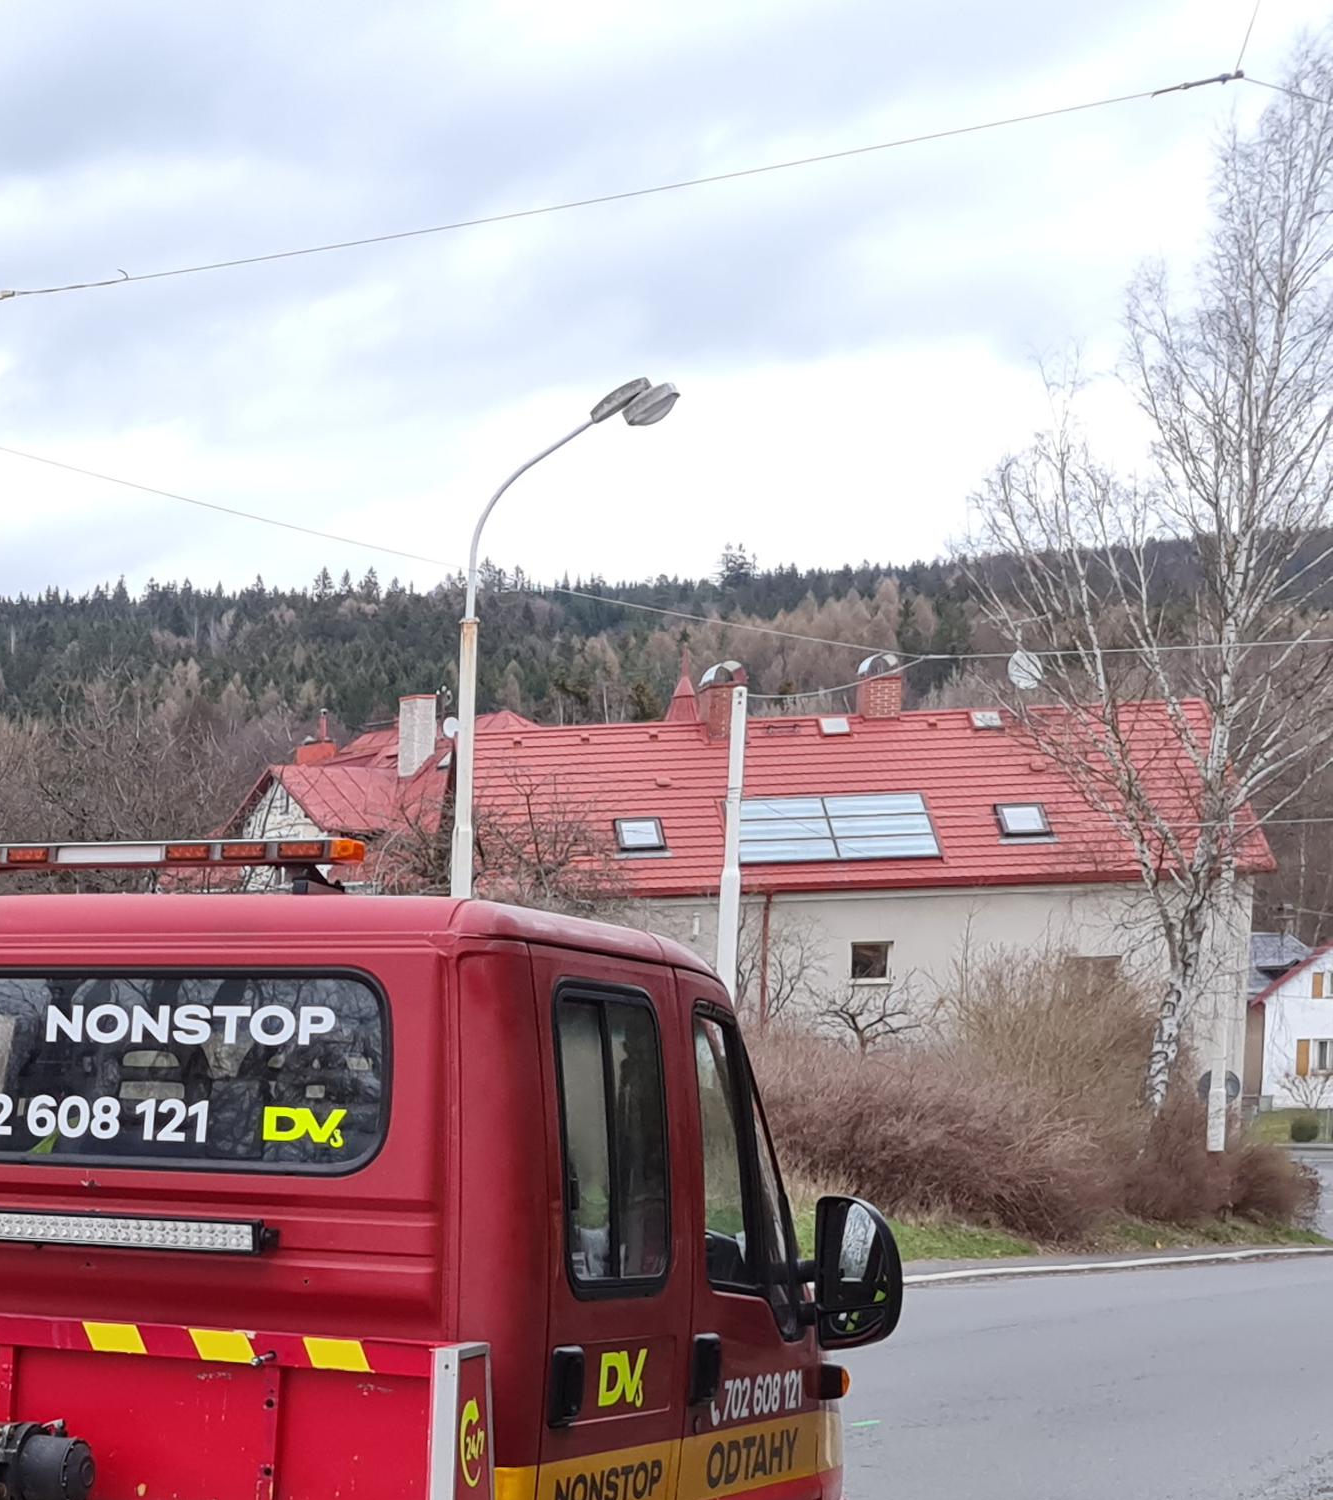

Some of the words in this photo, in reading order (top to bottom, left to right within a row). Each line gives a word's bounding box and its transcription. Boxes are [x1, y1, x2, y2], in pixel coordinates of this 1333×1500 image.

[45, 1004, 336, 1045] NONSTOP
[26, 1094, 120, 1140] 608
[135, 1099, 209, 1143] 121
[722, 1377, 751, 1421] 702
[753, 1372, 781, 1416] 608
[784, 1369, 802, 1410] 121
[706, 1427, 799, 1489] ODTAHY
